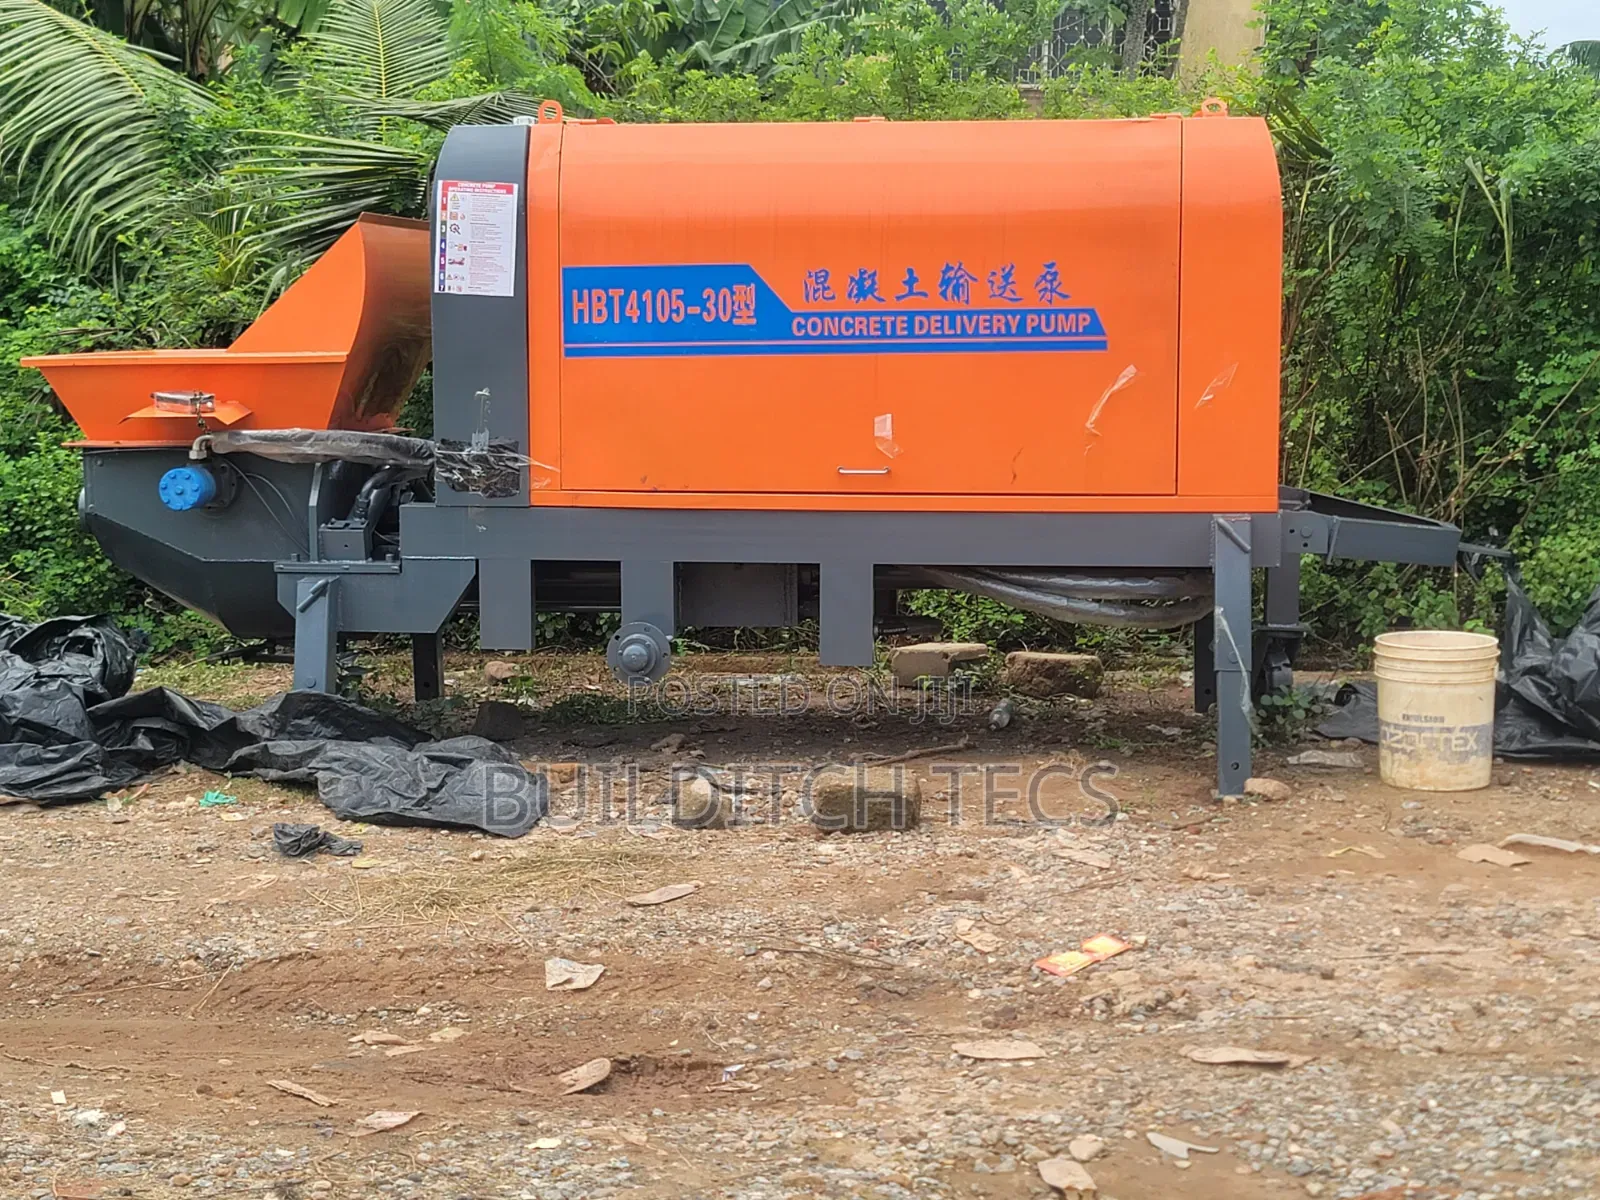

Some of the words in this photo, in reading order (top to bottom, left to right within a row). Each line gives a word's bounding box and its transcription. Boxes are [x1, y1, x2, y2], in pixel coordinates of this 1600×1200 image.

[571, 283, 757, 325] HBT4105-30型
[803, 262, 1072, 305] 混凝土输送泵
[791, 315, 908, 337] CONCRETE
[913, 315, 1021, 336] DELIVERY
[1025, 312, 1092, 334] PUMP
